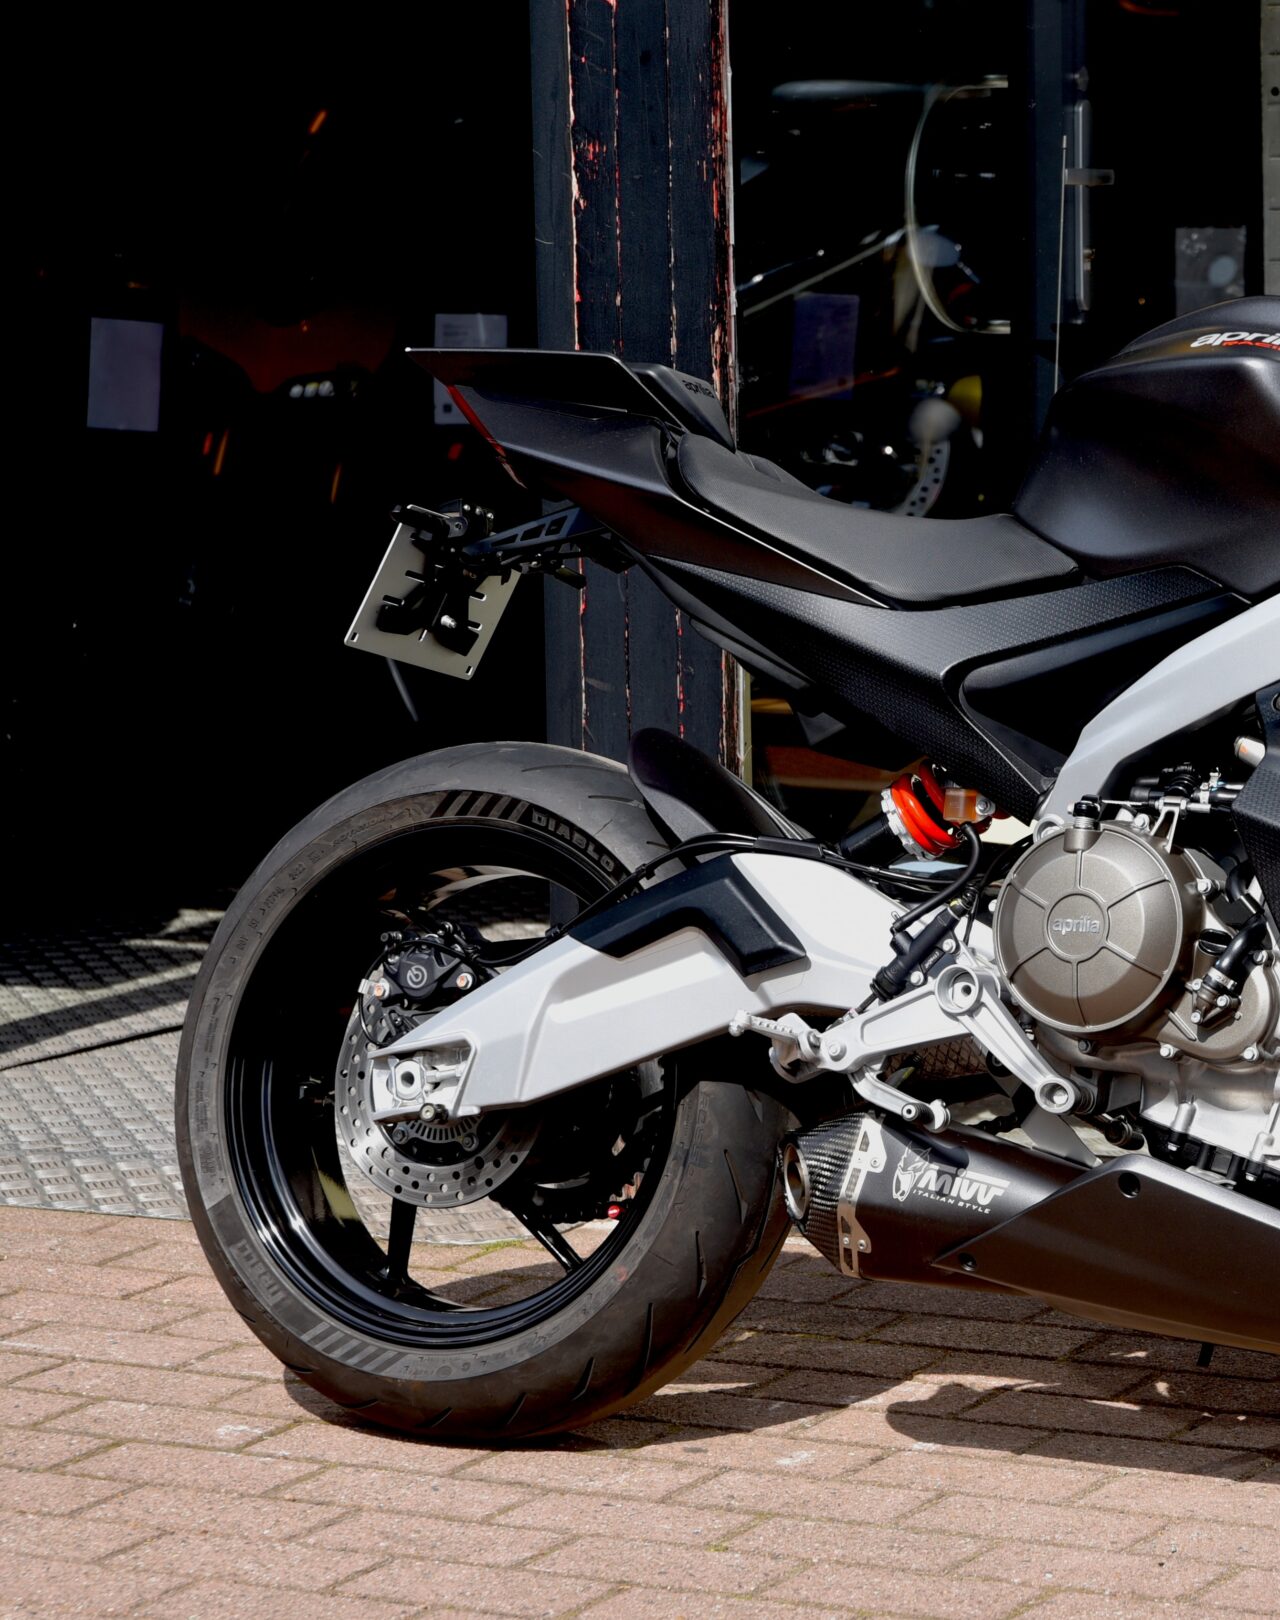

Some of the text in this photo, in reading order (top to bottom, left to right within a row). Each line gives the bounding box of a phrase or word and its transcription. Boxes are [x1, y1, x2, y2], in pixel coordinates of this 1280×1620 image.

[531, 807, 616, 872] DIABLO
[1052, 913, 1100, 935] aprilia
[912, 1189, 992, 1214] ITALIAN STYLE
